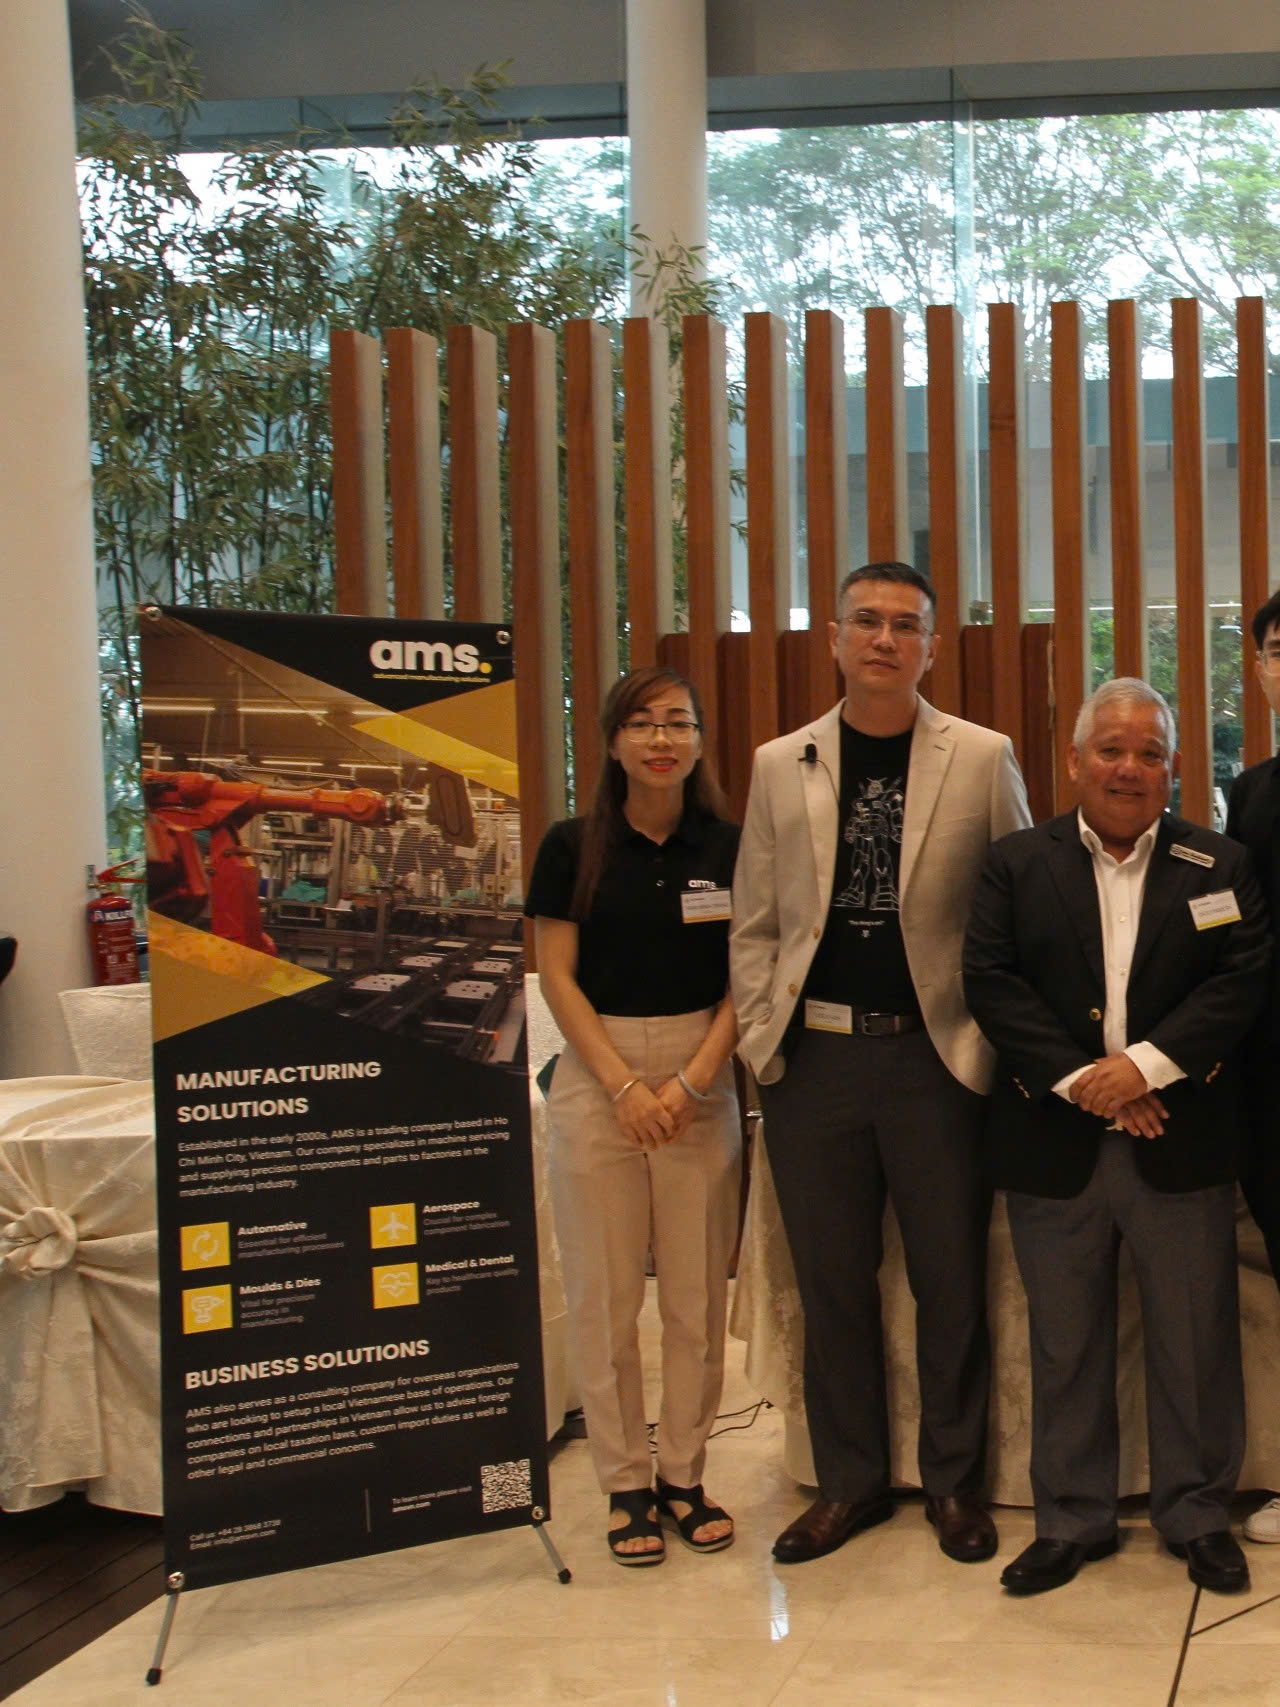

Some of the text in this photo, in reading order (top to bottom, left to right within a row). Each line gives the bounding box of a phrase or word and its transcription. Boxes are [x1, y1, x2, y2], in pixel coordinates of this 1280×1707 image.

[369, 640, 493, 673] ams.
[176, 1060, 382, 1090] MANUFACTURING
[177, 1096, 308, 1123] SOLUTIONS
[177, 1138, 237, 1153] Established
[238, 1138, 249, 1147] in
[250, 1136, 267, 1146] the
[269, 1134, 294, 1145] early
[330, 1128, 354, 1139] AMS
[356, 1128, 365, 1137] is
[375, 1125, 408, 1135] trading
[410, 1122, 452, 1132] company
[454, 1117, 482, 1128] based
[483, 1117, 492, 1125] in
[493, 1116, 507, 1125] Ho
[178, 1157, 195, 1168] Chi
[197, 1154, 223, 1166] Minh
[295, 1147, 314, 1157] Our
[315, 1144, 361, 1155] company
[362, 1138, 415, 1152] specializes
[417, 1137, 426, 1146] in
[427, 1133, 467, 1145] machine
[468, 1130, 509, 1141] servicing
[178, 1145, 488, 1182] and supplying precision components and parts to factories in the
[178, 1182, 254, 1197] manufacturing
[422, 1201, 480, 1213] Aerospace
[237, 1221, 307, 1236] Automotive
[424, 1253, 513, 1272] Medical & Dental
[239, 1278, 321, 1295] Moulds & Dies
[185, 1338, 429, 1389] BUSINESS SOLUTIONS
[185, 1405, 211, 1418] AMS
[213, 1404, 236, 1414] also
[237, 1399, 272, 1410] serves
[273, 1396, 286, 1404] as
[297, 1387, 349, 1401] consulting
[350, 1380, 395, 1393] company
[396, 1377, 411, 1386] for
[412, 1371, 455, 1383] overseas
[457, 1362, 518, 1377] organizations
[186, 1422, 209, 1433] who
[210, 1420, 228, 1429] are
[230, 1414, 268, 1426] looking
[269, 1412, 281, 1420] to
[282, 1407, 311, 1418] setup
[321, 1400, 346, 1412] local
[347, 1393, 405, 1408] Vietnamese
[406, 1389, 430, 1399] base
[431, 1386, 442, 1395] of
[496, 1376, 513, 1385] Our
[186, 1432, 251, 1448] connections
[253, 1426, 273, 1438] and
[274, 1418, 337, 1437] partnerships
[339, 1416, 349, 1424] in
[350, 1410, 391, 1422] Vietnam
[392, 1406, 418, 1416] allow
[433, 1401, 444, 1409] to
[445, 1396, 476, 1407] advise
[477, 1391, 510, 1402] foreign
[186, 1447, 245, 1464] companies
[247, 1445, 261, 1454] on
[263, 1439, 288, 1451] local
[289, 1434, 331, 1447] taxation
[359, 1424, 396, 1436] custom
[397, 1417, 429, 1430] import
[431, 1413, 460, 1424] duties
[462, 1411, 474, 1419] as
[475, 1406, 494, 1417] well
[495, 1406, 507, 1414] as
[187, 1467, 215, 1479] other
[217, 1461, 243, 1474] legal
[245, 1457, 265, 1469] and
[267, 1448, 326, 1466] commercial
